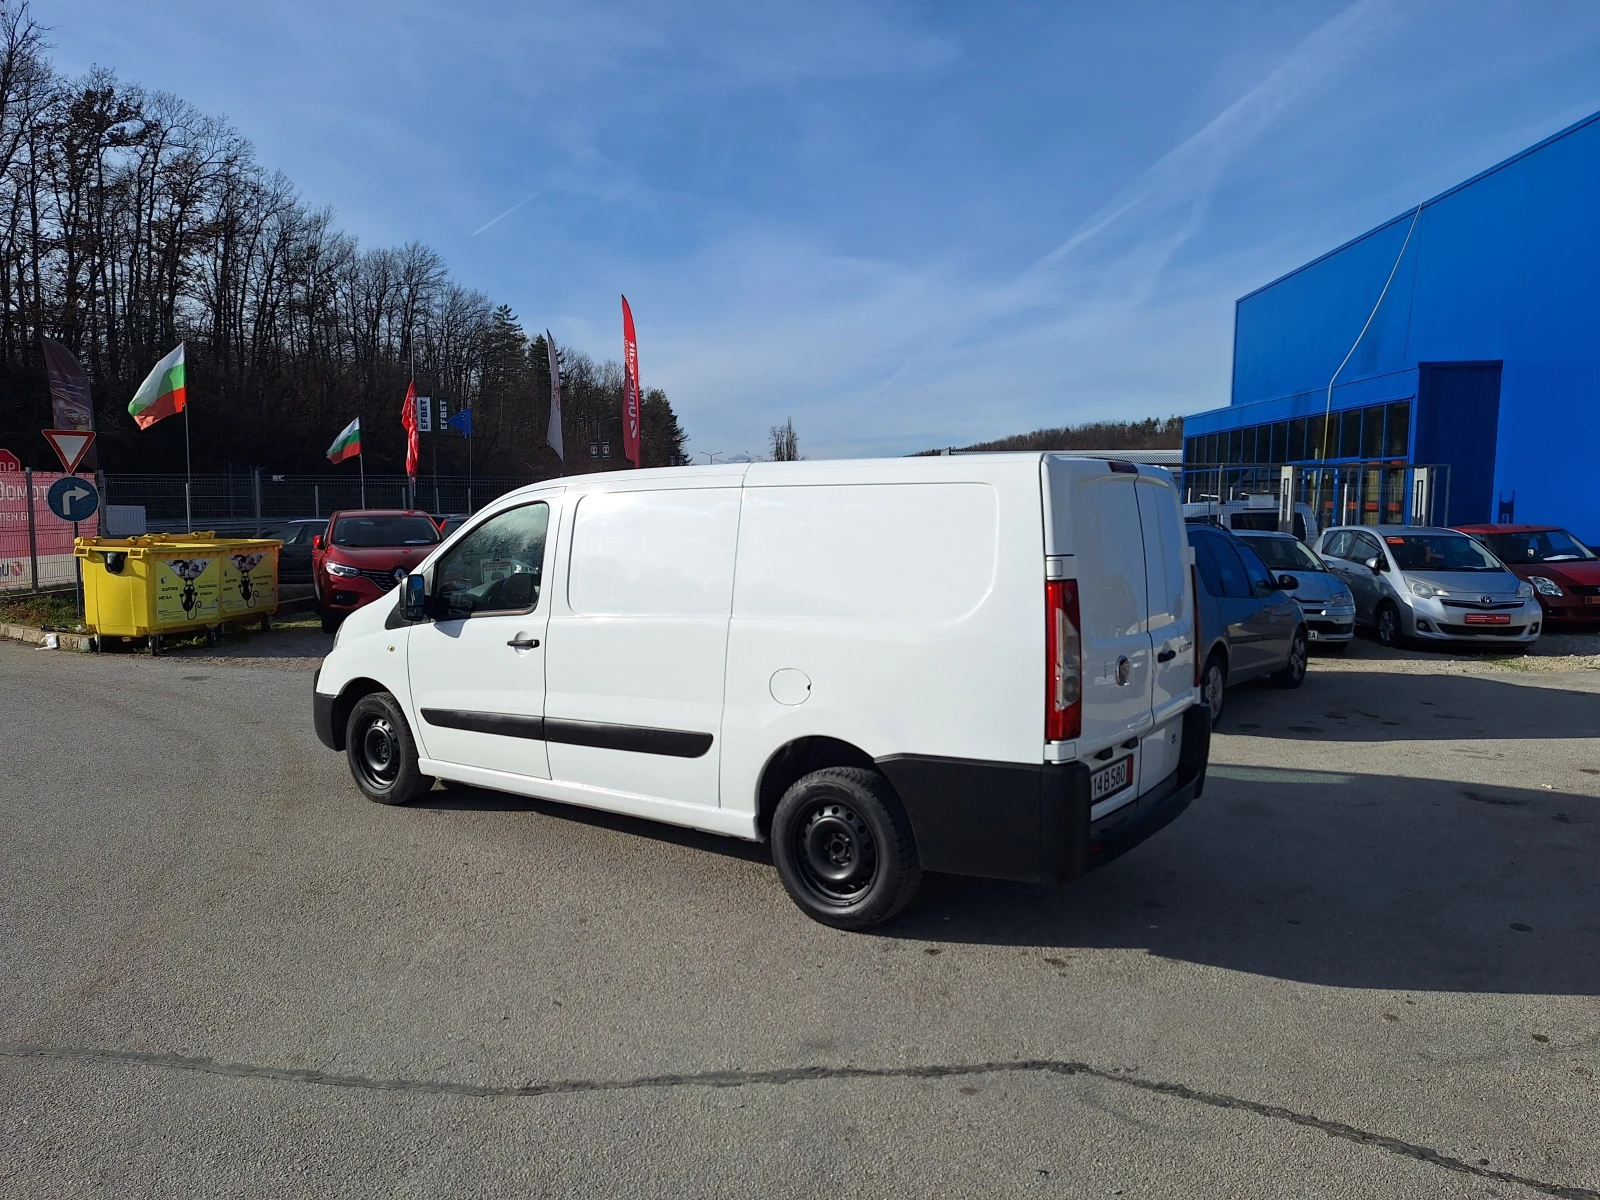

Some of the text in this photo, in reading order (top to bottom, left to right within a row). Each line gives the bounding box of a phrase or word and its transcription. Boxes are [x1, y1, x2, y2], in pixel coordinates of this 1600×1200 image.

[420, 399, 428, 430] EFBET
[440, 399, 448, 430] EFBET
[0, 461, 16, 472] OP
[1093, 763, 1125, 797] 14B580
